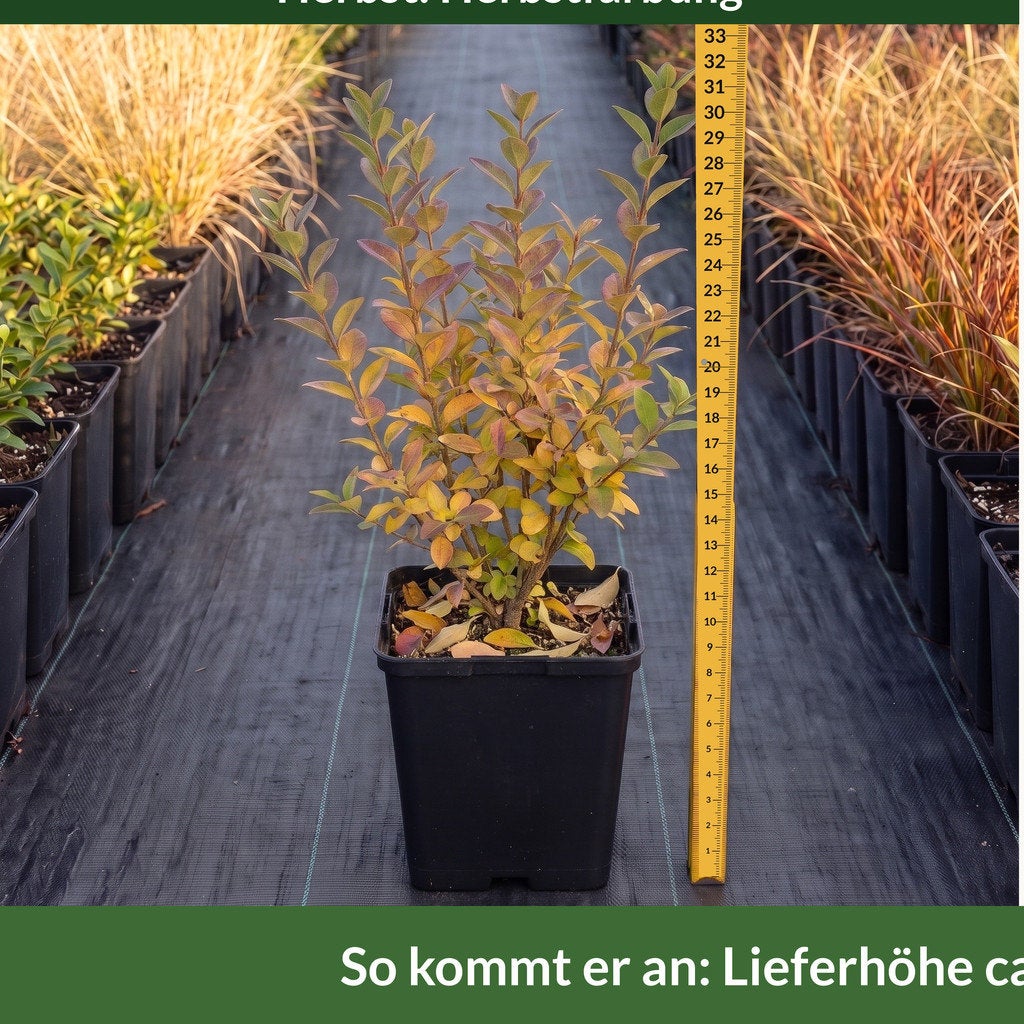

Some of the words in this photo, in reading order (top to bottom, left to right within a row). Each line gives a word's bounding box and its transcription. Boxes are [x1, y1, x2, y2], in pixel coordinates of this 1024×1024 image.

[704, 28, 726, 43] 33
[704, 54, 725, 69] 32
[704, 79, 724, 94] 31
[704, 105, 725, 120] 30
[704, 130, 725, 145] 29
[704, 156, 724, 170] 28
[704, 181, 724, 196] 27
[704, 207, 723, 221] 26
[704, 232, 722, 246] 25
[704, 258, 724, 272] 24
[704, 284, 722, 297] 23
[704, 309, 722, 322] 22
[704, 335, 722, 347] 21
[704, 361, 721, 373] 20
[705, 386, 720, 398] 19
[705, 412, 720, 424] 18
[705, 438, 720, 449] 17
[705, 463, 719, 474] 16
[705, 489, 718, 500] 15
[705, 514, 718, 525] 14
[705, 540, 718, 550] 13
[705, 566, 717, 576] 12
[704, 591, 718, 601] 11
[705, 617, 717, 626] 10
[707, 642, 713, 652] 9
[706, 668, 713, 677] 8
[706, 694, 712, 702] 7
[706, 719, 712, 728] 6
[706, 745, 712, 753] 5
[706, 770, 712, 778] 4
[706, 796, 711, 804] 3
